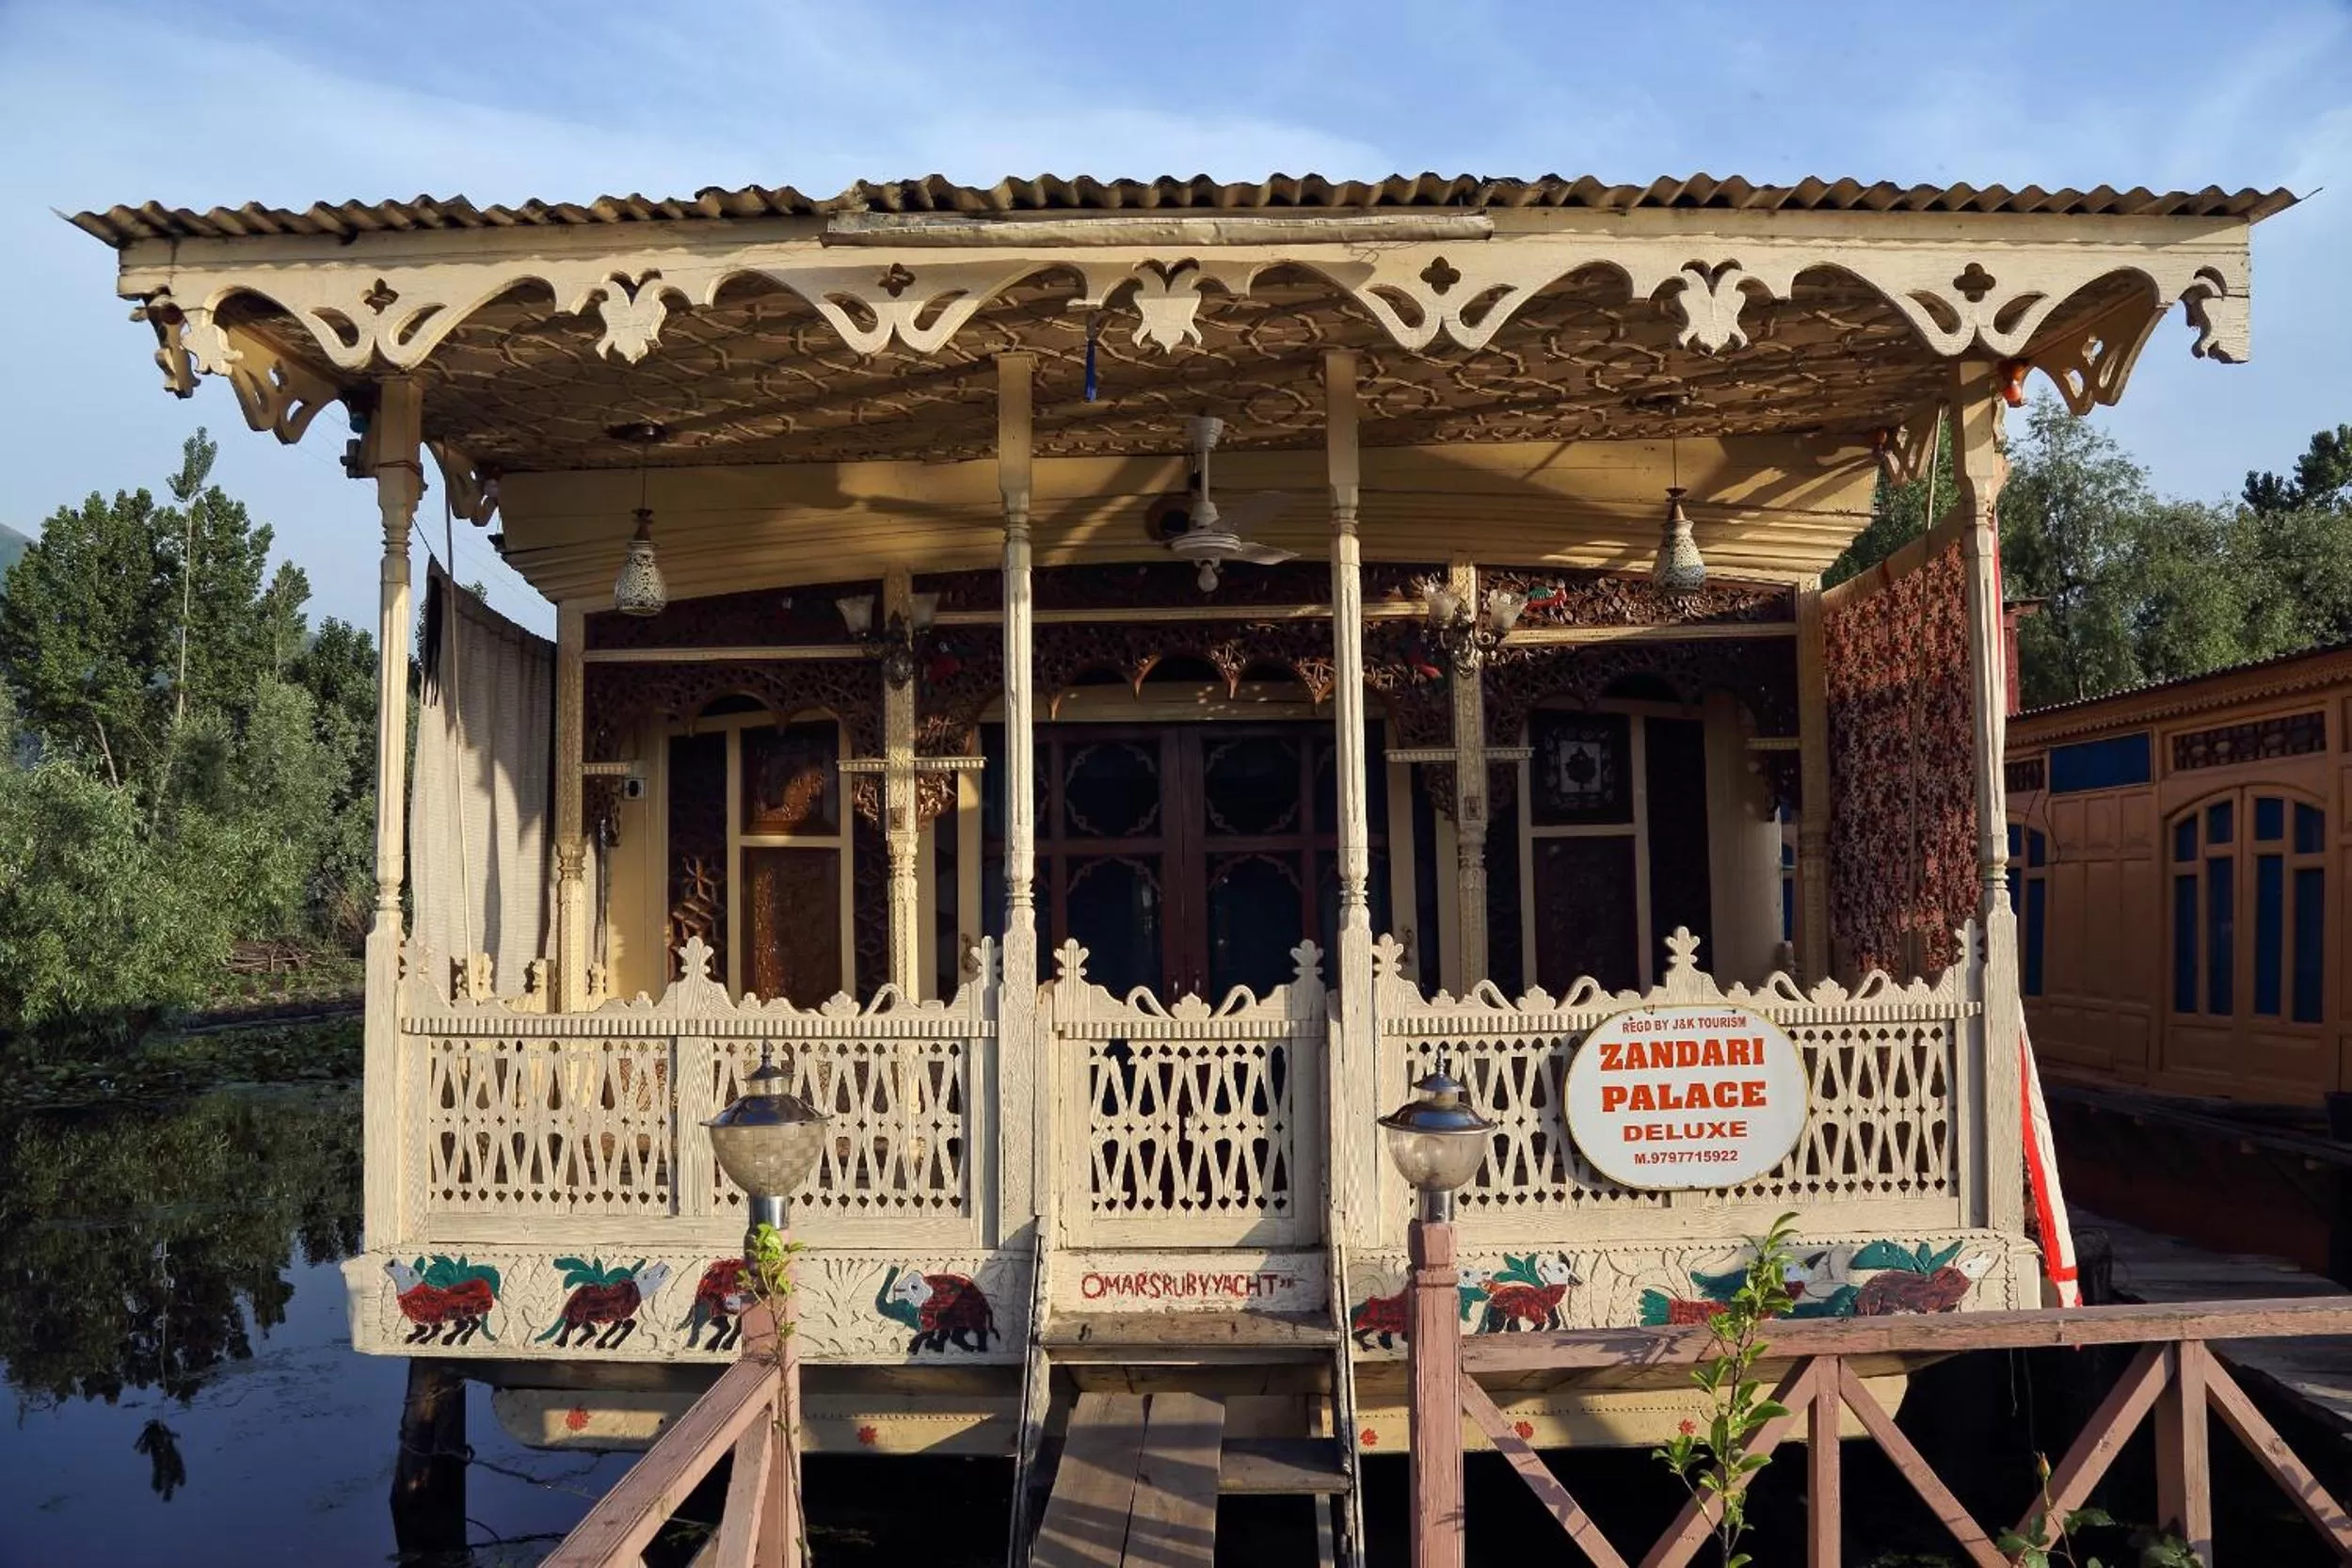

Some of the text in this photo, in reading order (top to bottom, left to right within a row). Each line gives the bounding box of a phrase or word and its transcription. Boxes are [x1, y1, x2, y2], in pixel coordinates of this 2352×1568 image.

[1622, 1016, 1747, 1033] REGD BY J&K TOURISM
[1600, 1038, 1765, 1071] ZANDARI
[1602, 1080, 1767, 1112] PALACE
[1624, 1120, 1748, 1143] DELUXE
[1635, 1150, 1738, 1164] M.9797715922
